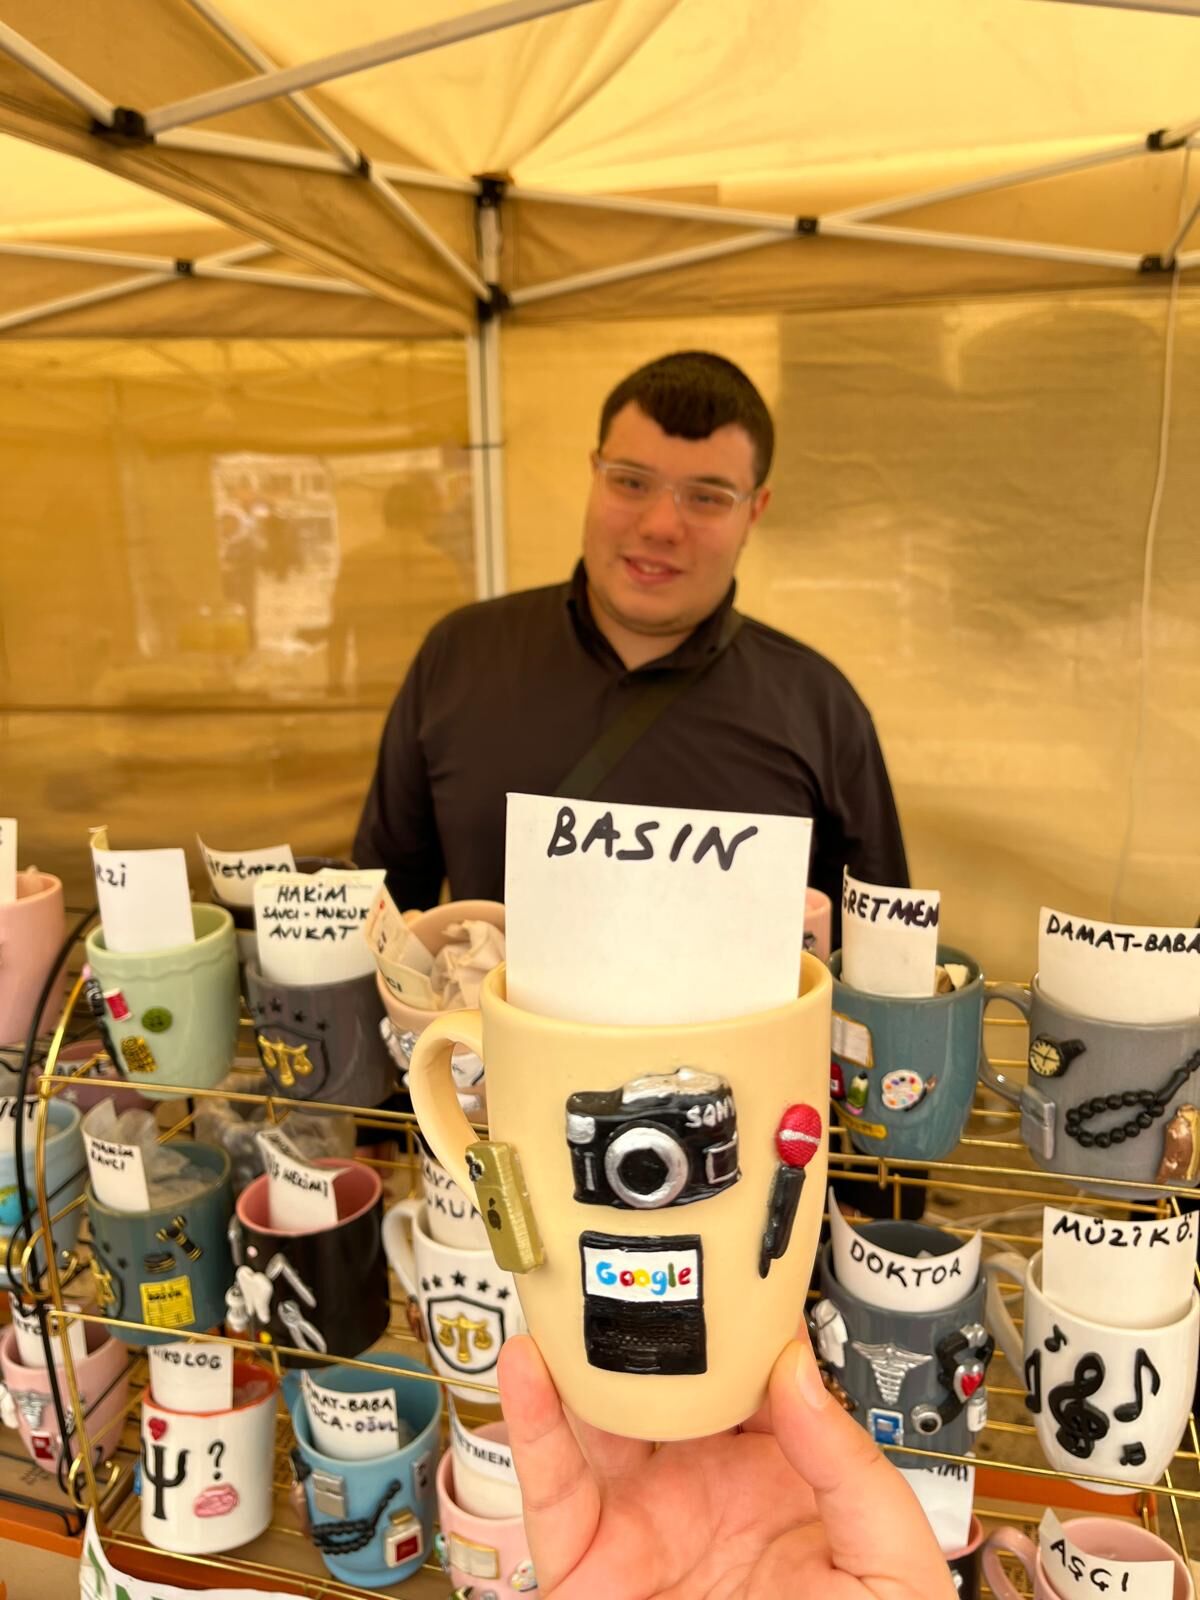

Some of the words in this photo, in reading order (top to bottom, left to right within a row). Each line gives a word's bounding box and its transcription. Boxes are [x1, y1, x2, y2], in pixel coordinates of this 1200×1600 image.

[547, 806, 758, 871] BASIN
[269, 925, 359, 941] AVUKAT
[596, 1261, 691, 1295] Google
